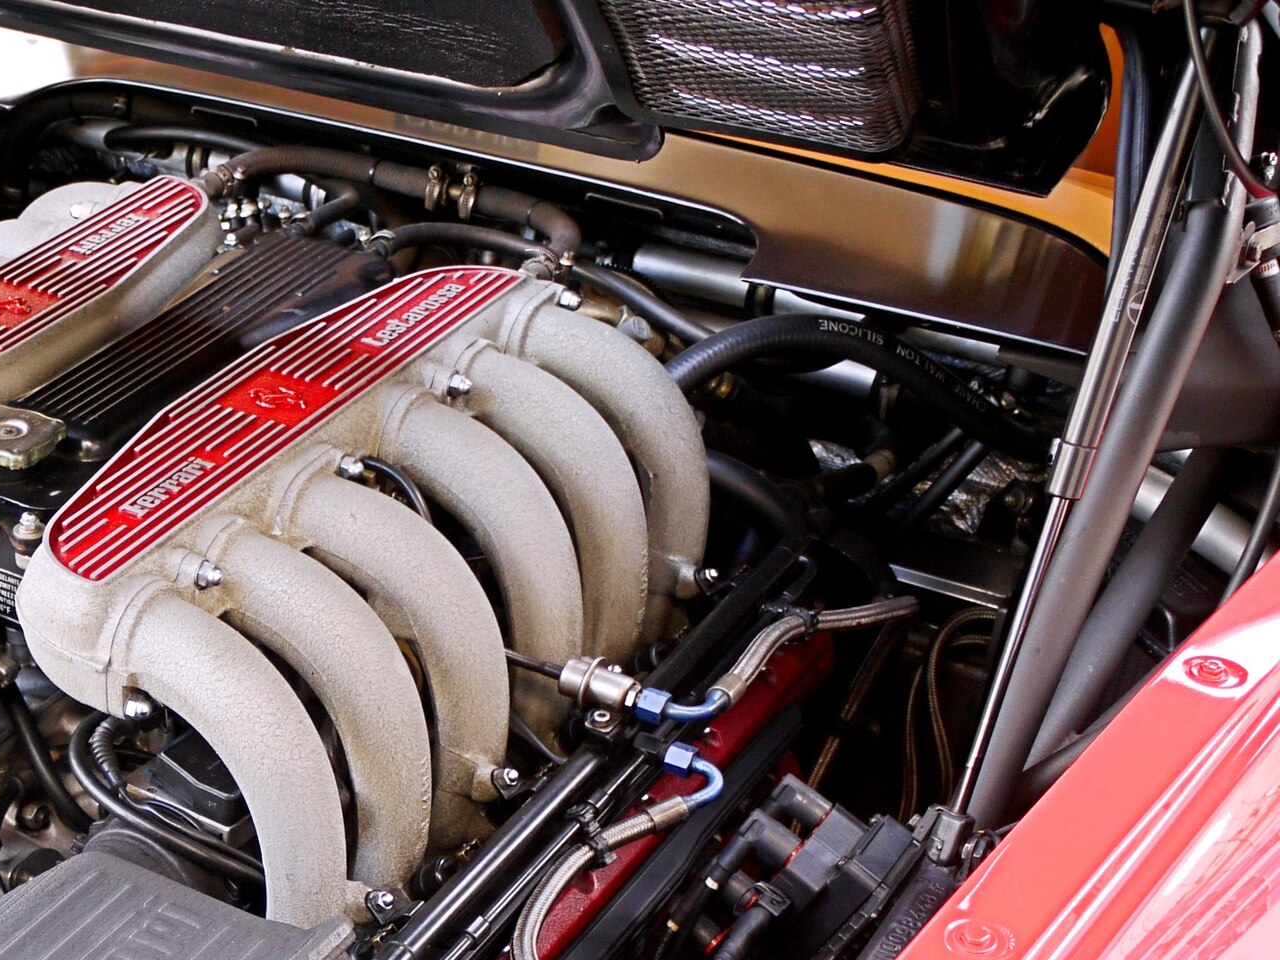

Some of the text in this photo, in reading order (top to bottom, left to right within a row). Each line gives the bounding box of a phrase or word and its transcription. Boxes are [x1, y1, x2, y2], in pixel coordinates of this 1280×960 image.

[69, 212, 148, 256] Ferrari
[818, 319, 885, 346] SILICONE
[896, 343, 946, 383] WALTON
[119, 456, 216, 519] Ferrari
